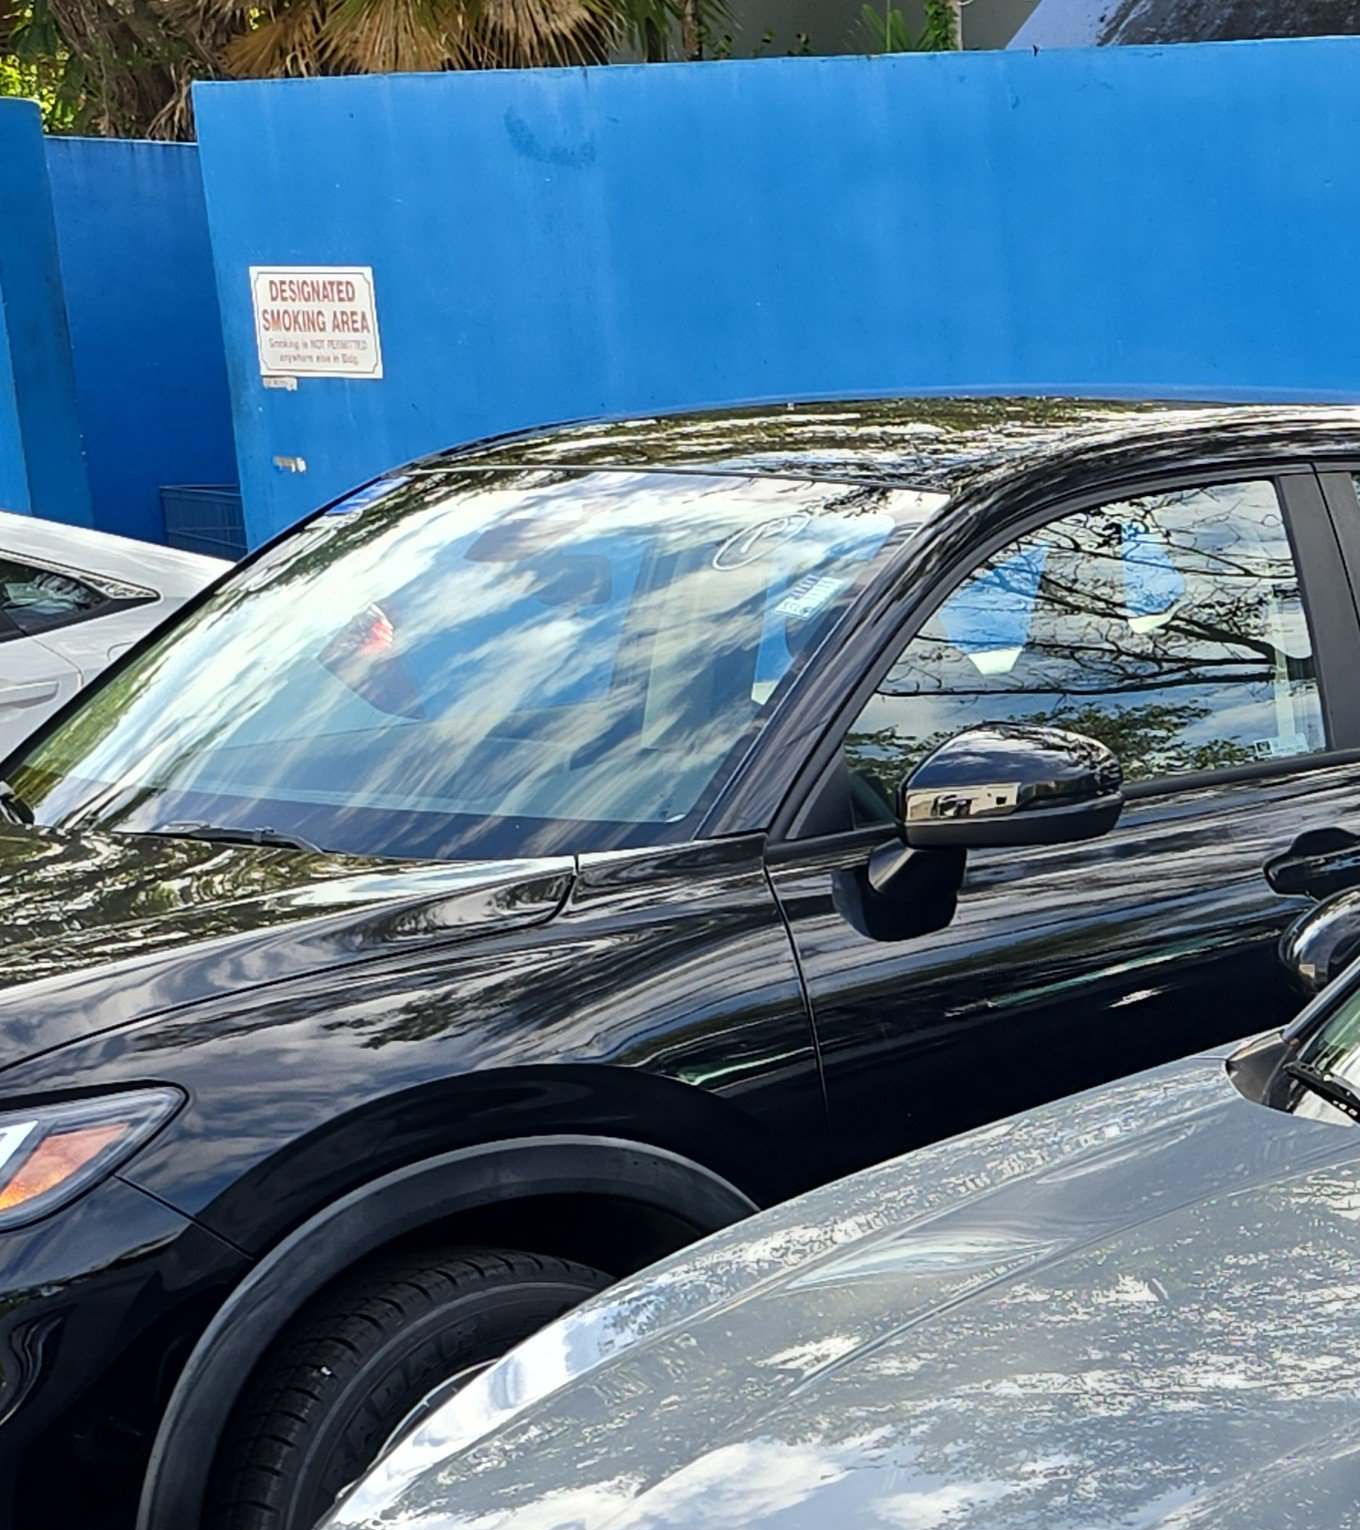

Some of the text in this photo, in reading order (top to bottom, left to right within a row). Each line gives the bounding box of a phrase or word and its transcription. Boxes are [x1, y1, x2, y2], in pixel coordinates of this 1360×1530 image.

[269, 279, 356, 303] DESIGNATED
[262, 308, 371, 334] SMOKING AREA
